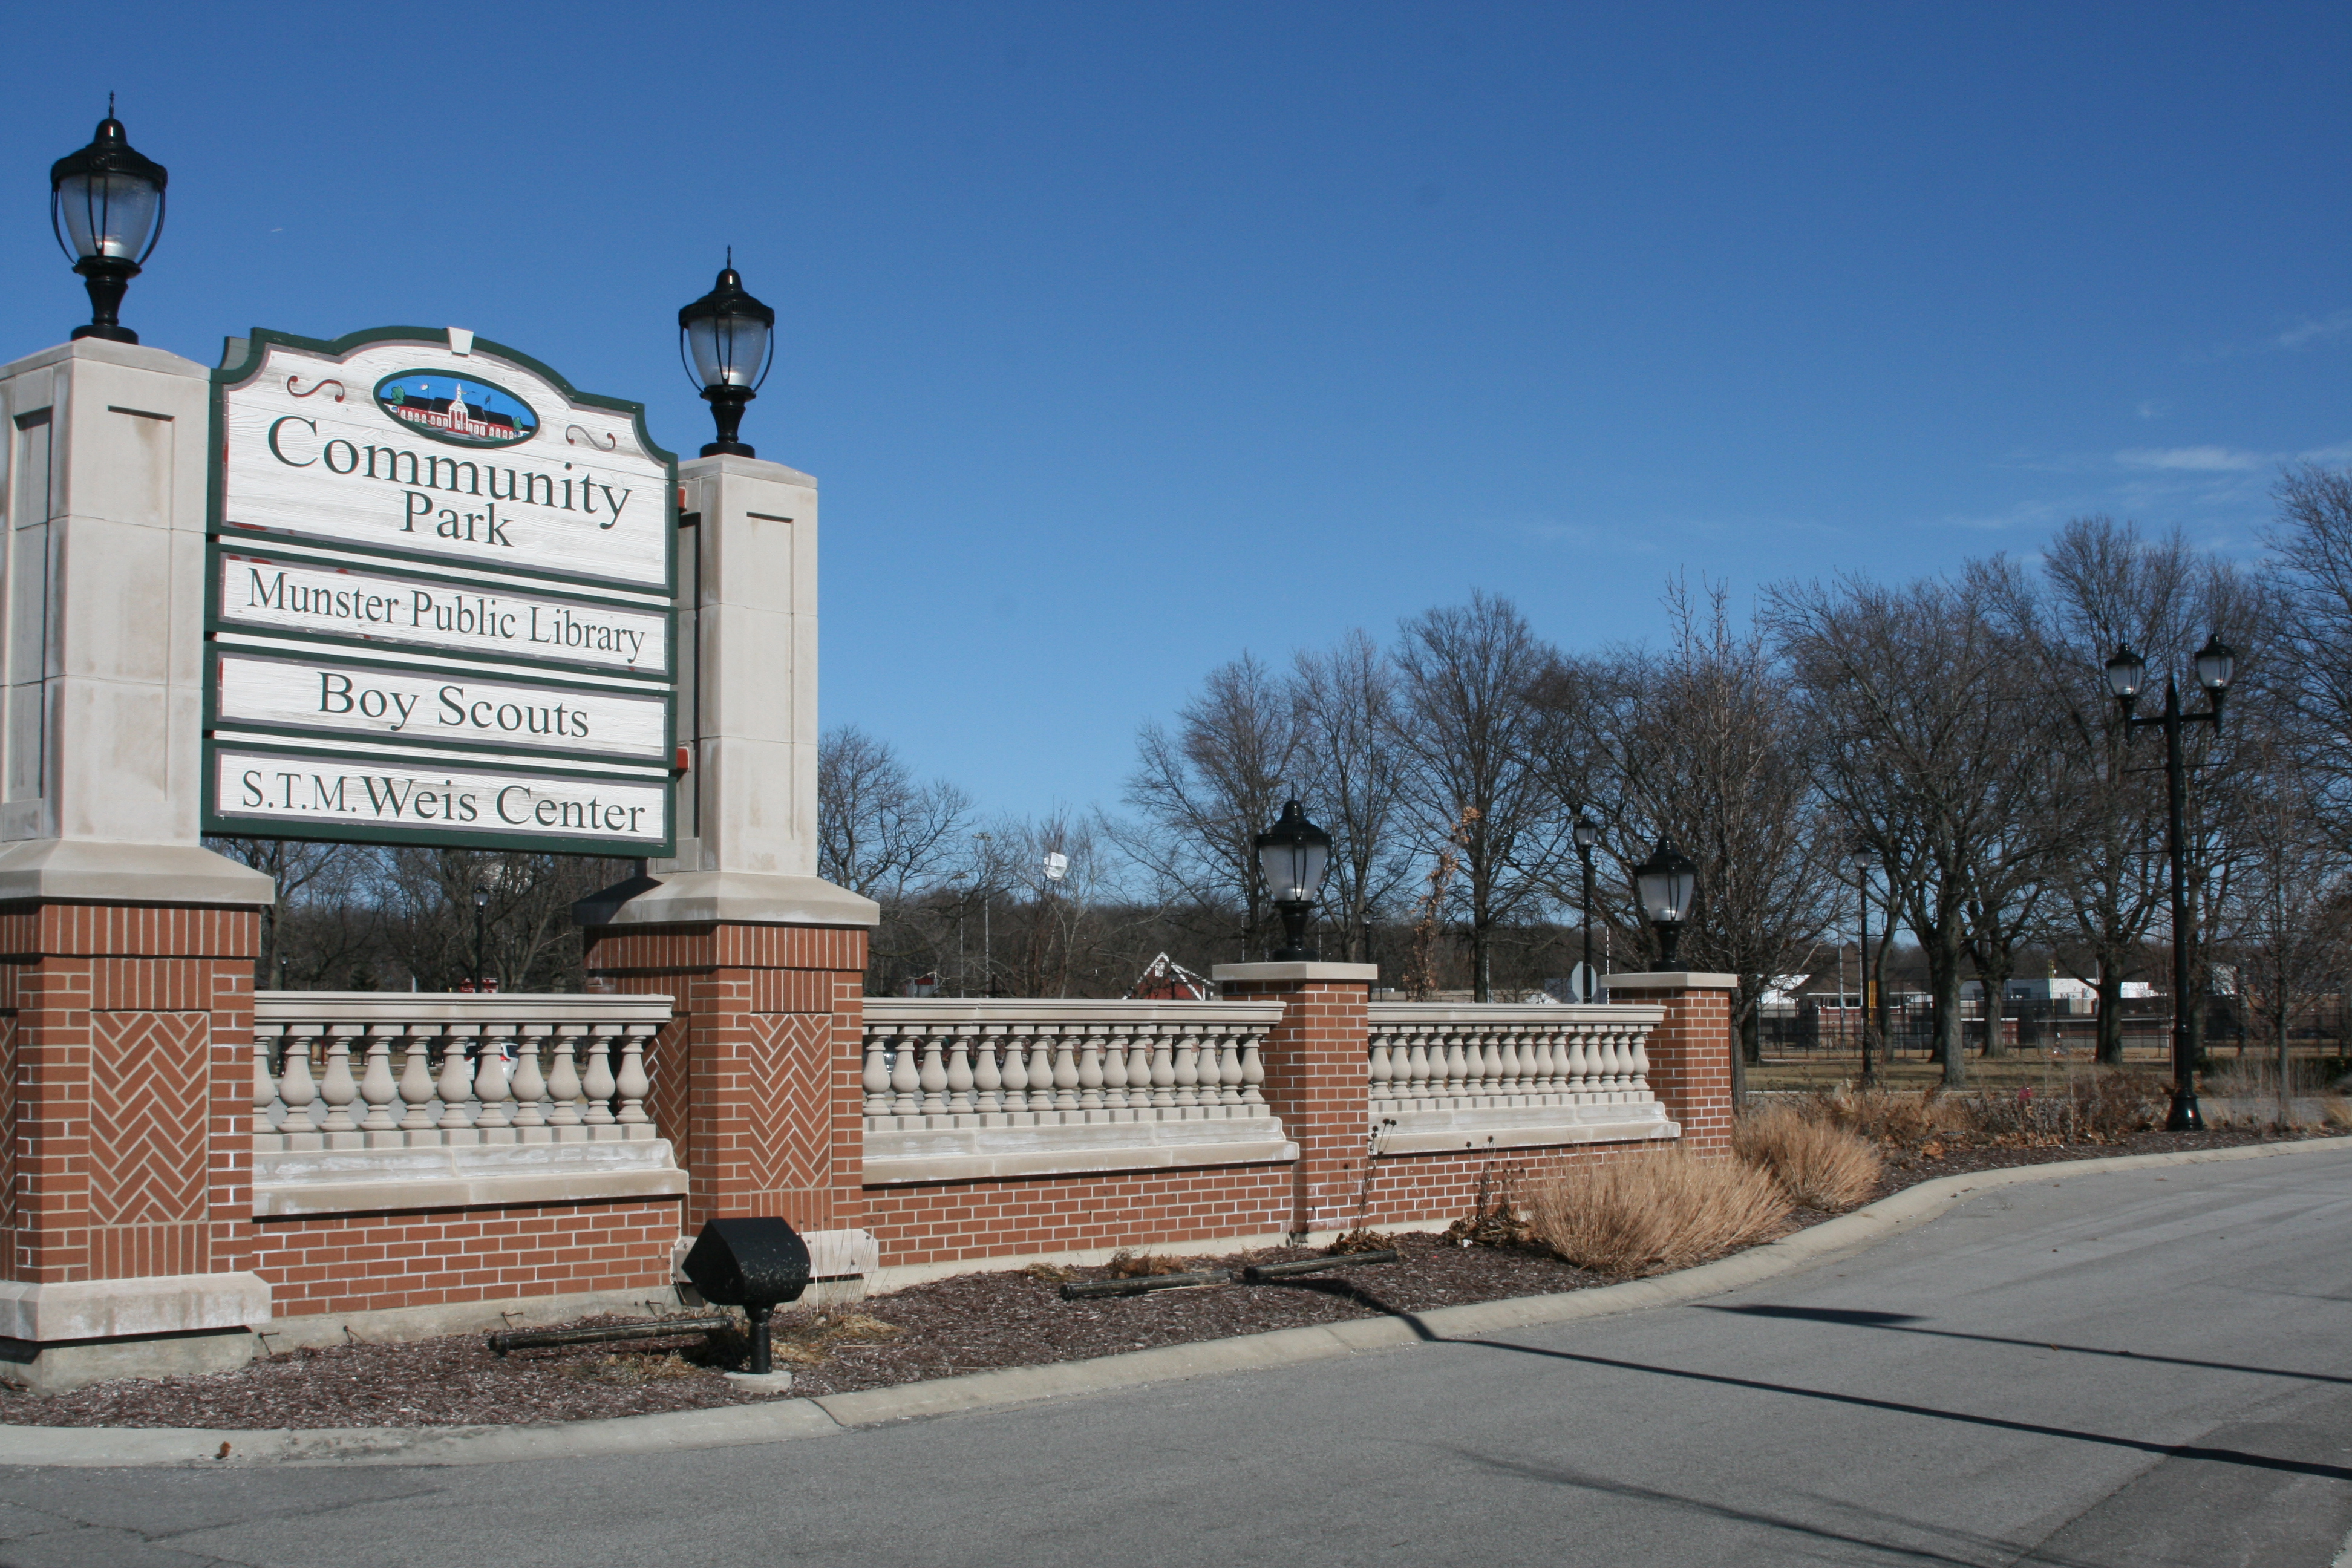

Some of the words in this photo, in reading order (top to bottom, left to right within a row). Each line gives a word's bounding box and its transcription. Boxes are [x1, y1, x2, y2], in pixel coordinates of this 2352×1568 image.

[269, 416, 633, 530] Community
[400, 490, 515, 547] Park
[247, 568, 399, 624] Munster
[411, 590, 516, 639] Public
[529, 607, 645, 664] Library
[318, 673, 419, 731] Boy
[439, 685, 589, 737] Scouts
[497, 785, 646, 832] Center
